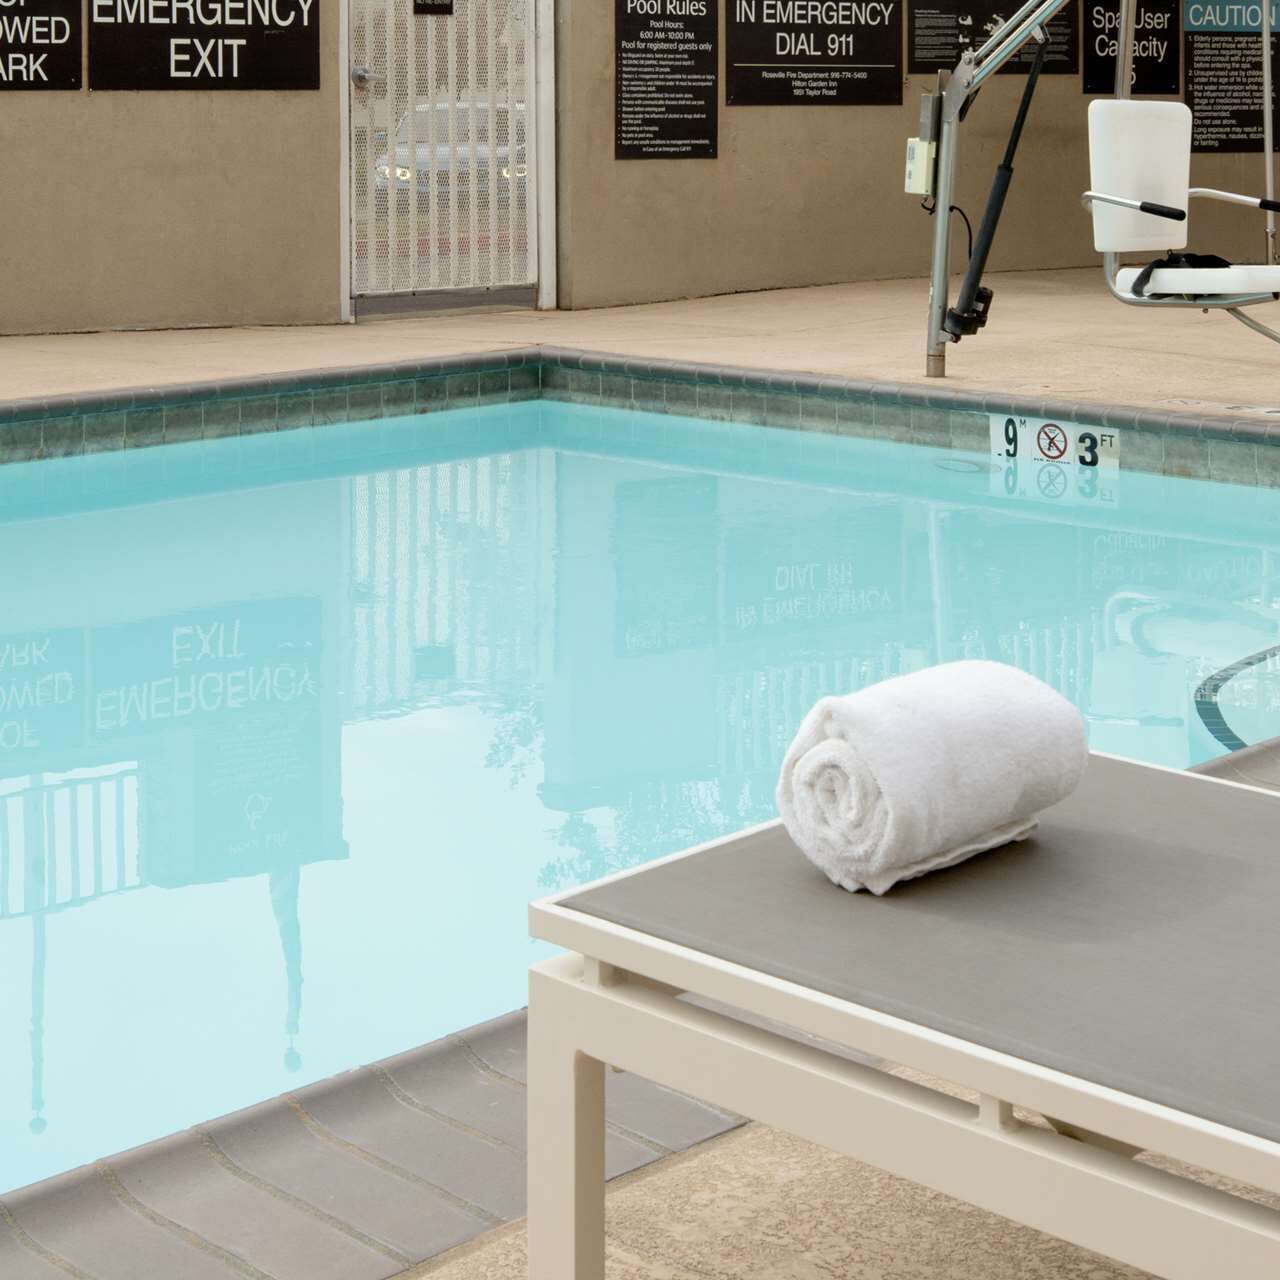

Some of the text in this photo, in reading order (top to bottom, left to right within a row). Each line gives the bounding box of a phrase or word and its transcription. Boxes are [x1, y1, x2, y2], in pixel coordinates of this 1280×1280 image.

[650, 20, 684, 29] Pool Hours:
[736, 0, 894, 25] IN EMERGENCY
[621, 40, 713, 52] Pool for registered guests only
[776, 33, 853, 56] DIAL 911
[1095, 35, 1168, 62] Caacity
[169, 38, 247, 78] EXIT
[1078, 432, 1115, 467] 3 FT
